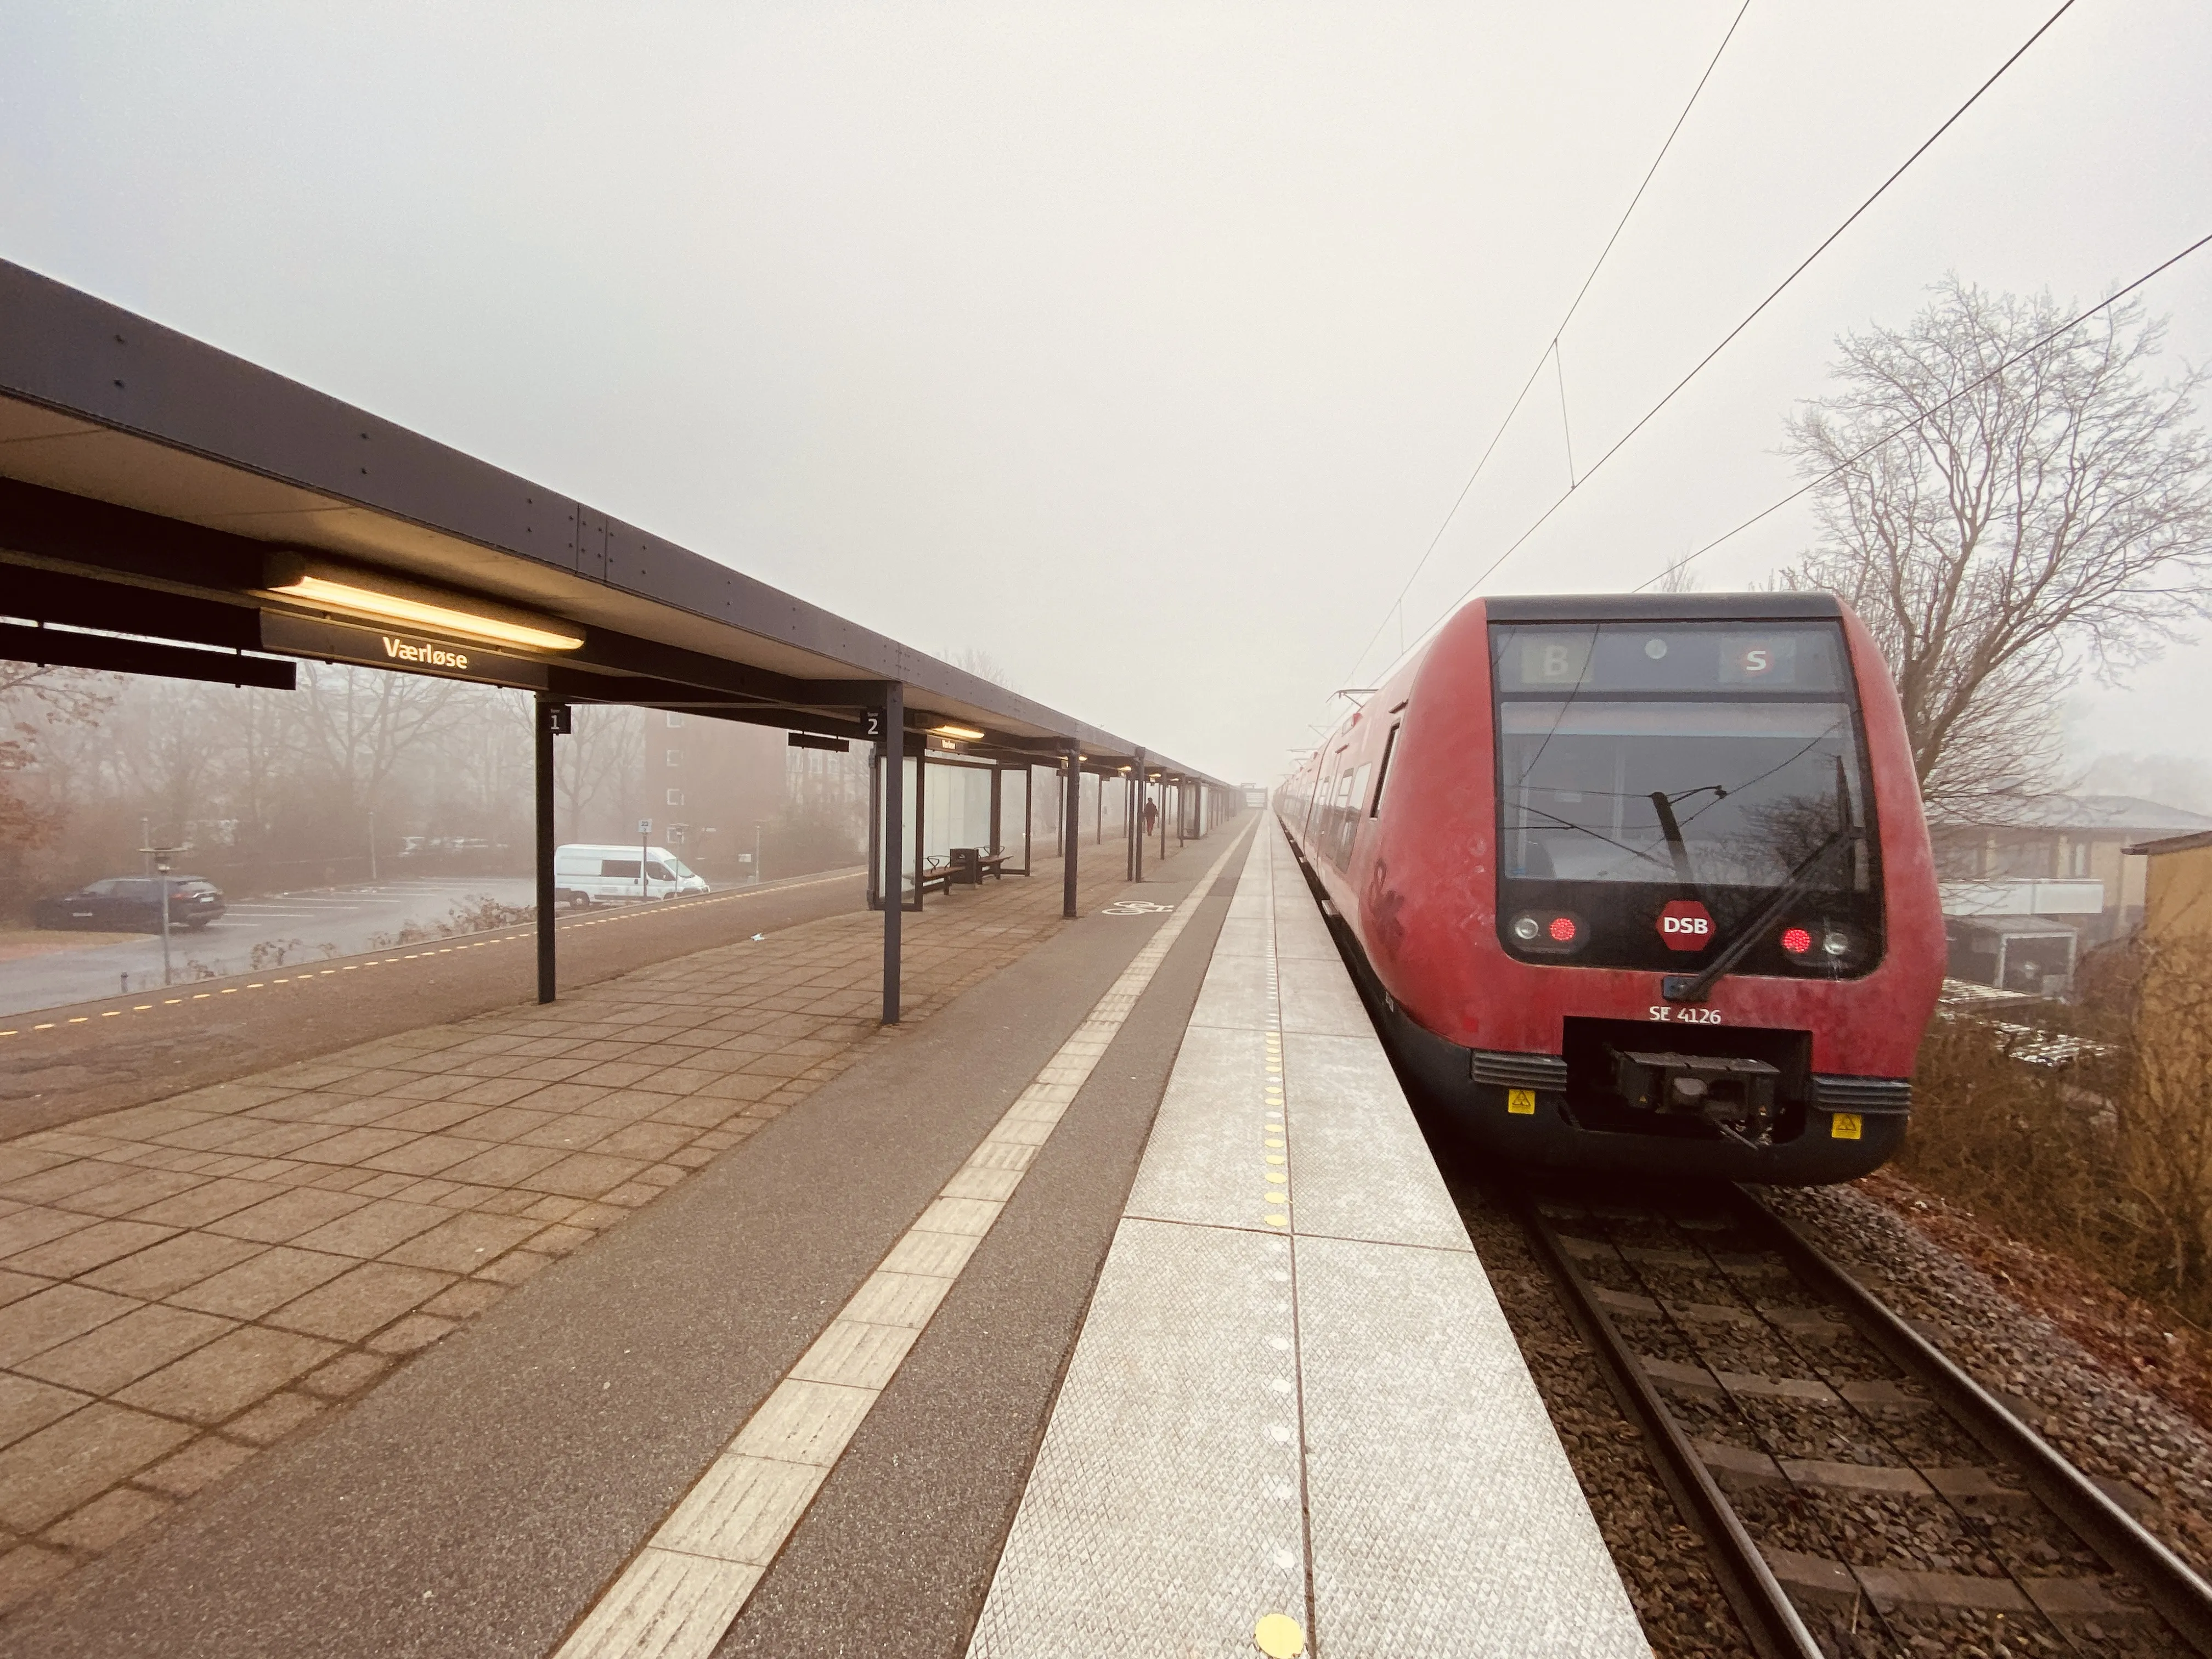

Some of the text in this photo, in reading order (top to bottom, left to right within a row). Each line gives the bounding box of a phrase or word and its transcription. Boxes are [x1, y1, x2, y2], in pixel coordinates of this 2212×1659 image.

[383, 636, 467, 669] Værløse
[1544, 646, 1568, 675] B
[1746, 651, 1766, 670] S
[551, 715, 560, 730] 1
[867, 719, 878, 735] 2
[1664, 917, 1708, 934] DSB
[1649, 1006, 1722, 1024] SE 4126
